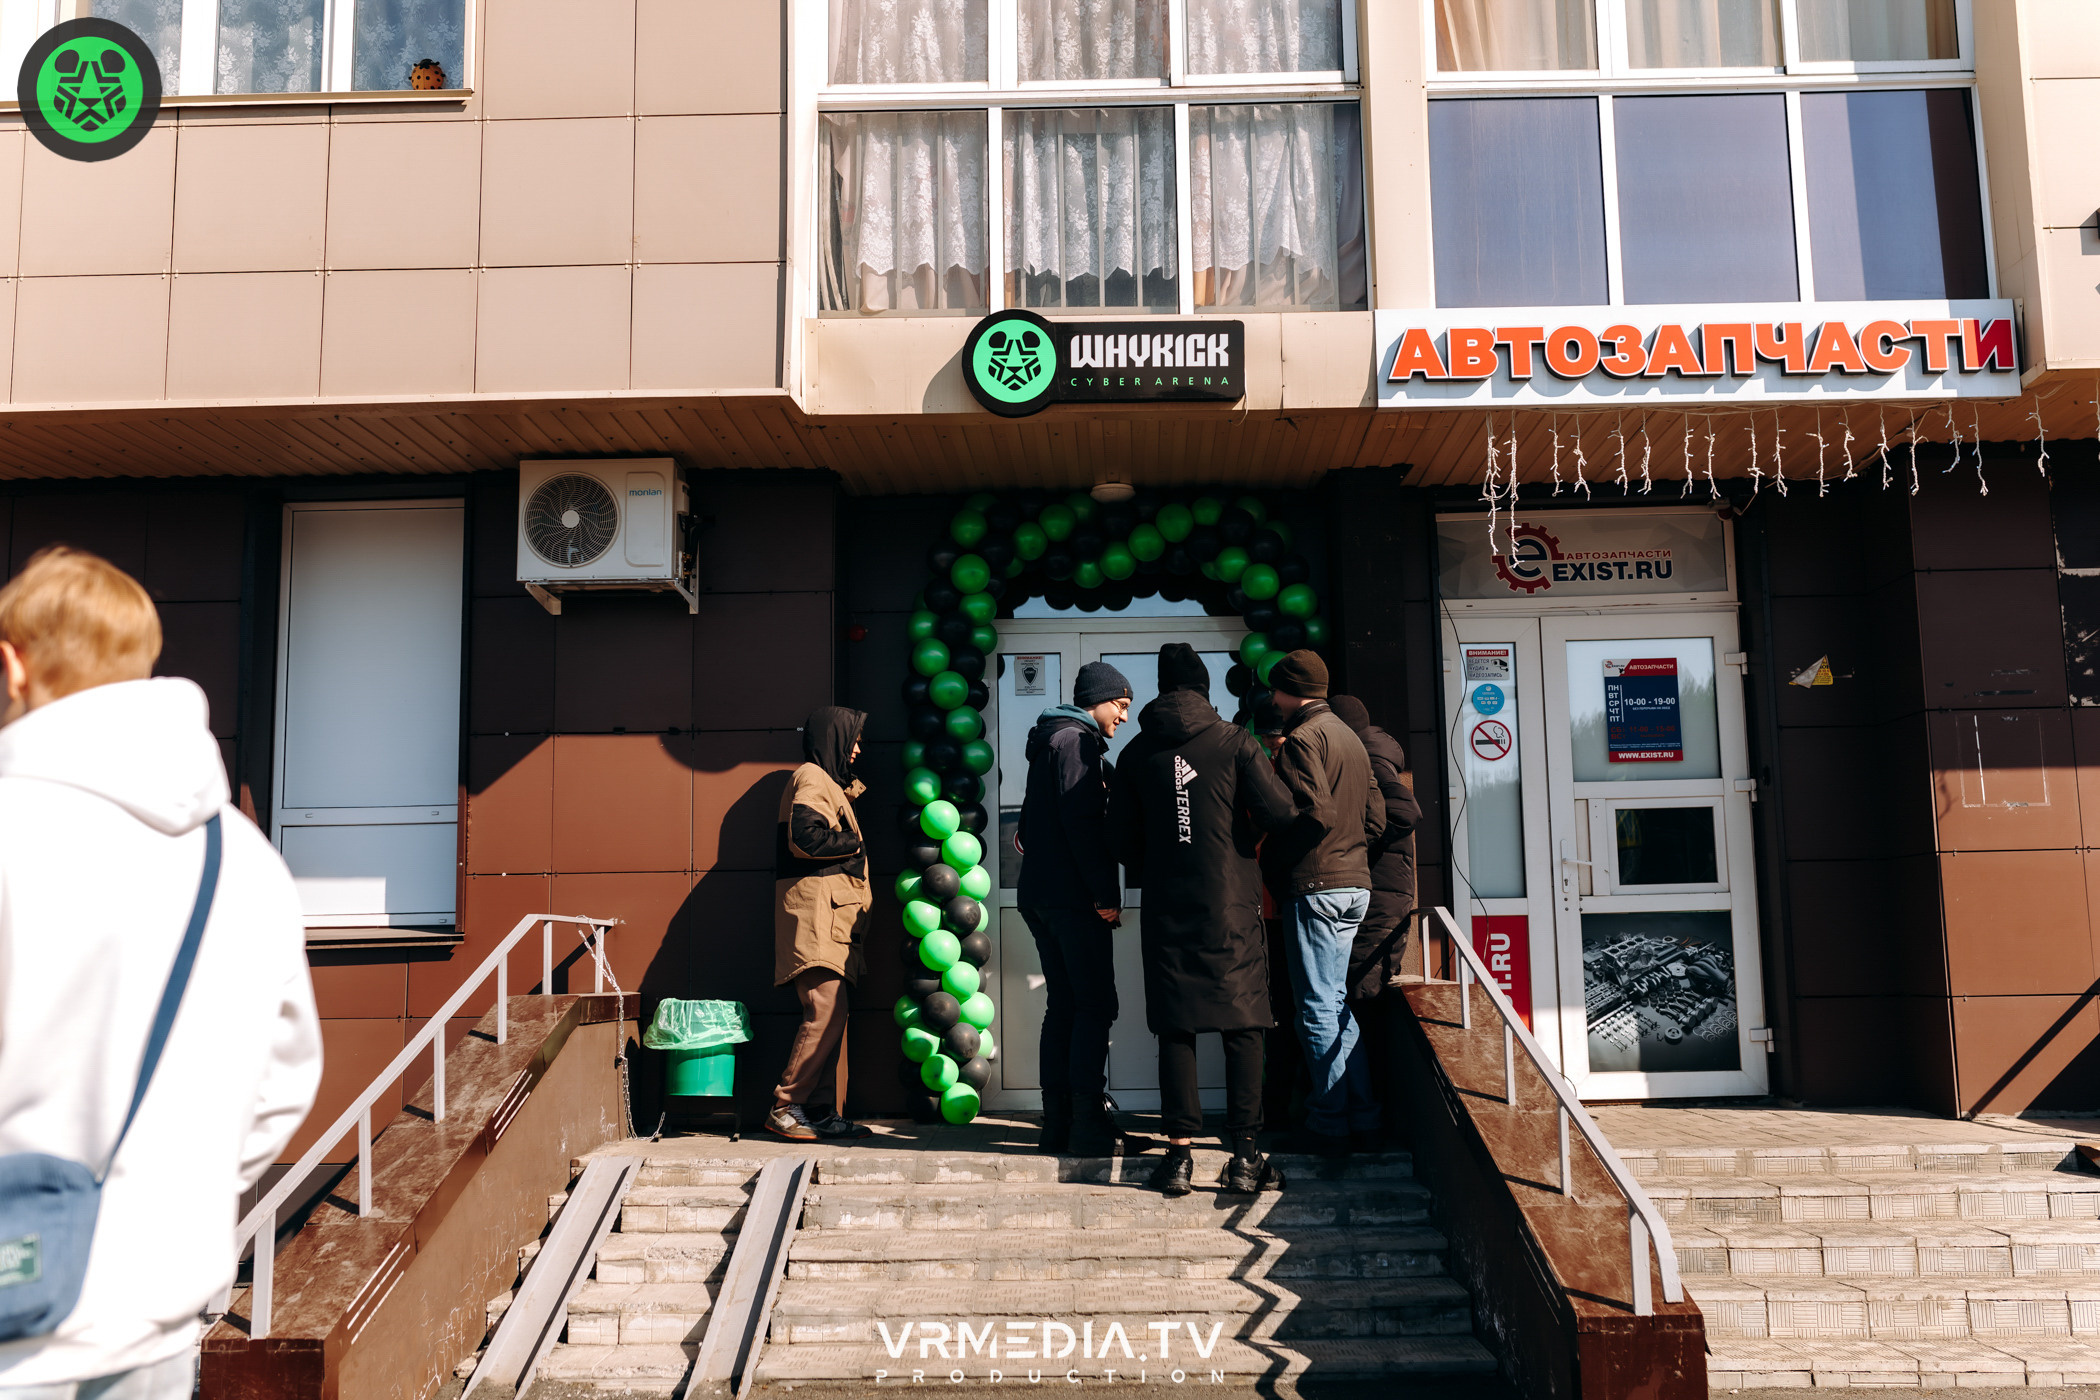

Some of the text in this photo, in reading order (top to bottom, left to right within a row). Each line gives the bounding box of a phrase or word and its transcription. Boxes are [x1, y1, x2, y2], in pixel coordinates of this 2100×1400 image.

[1070, 333, 1229, 368] WHYKICK
[1388, 317, 2017, 380] АВТОЗАПЧАСТИ
[1070, 376, 1229, 387] CYBER ARENA
[629, 488, 662, 496] monlan
[1566, 550, 1672, 560] АВТОЗАПЧАСТИ
[1552, 560, 1673, 582] EXIST.RU
[1624, 698, 1646, 706] 10-00
[1653, 697, 1676, 705] 19-00
[1174, 755, 1183, 790] adidas
[1176, 789, 1192, 844] TERREX
[1490, 933, 1513, 1006] T.RU
